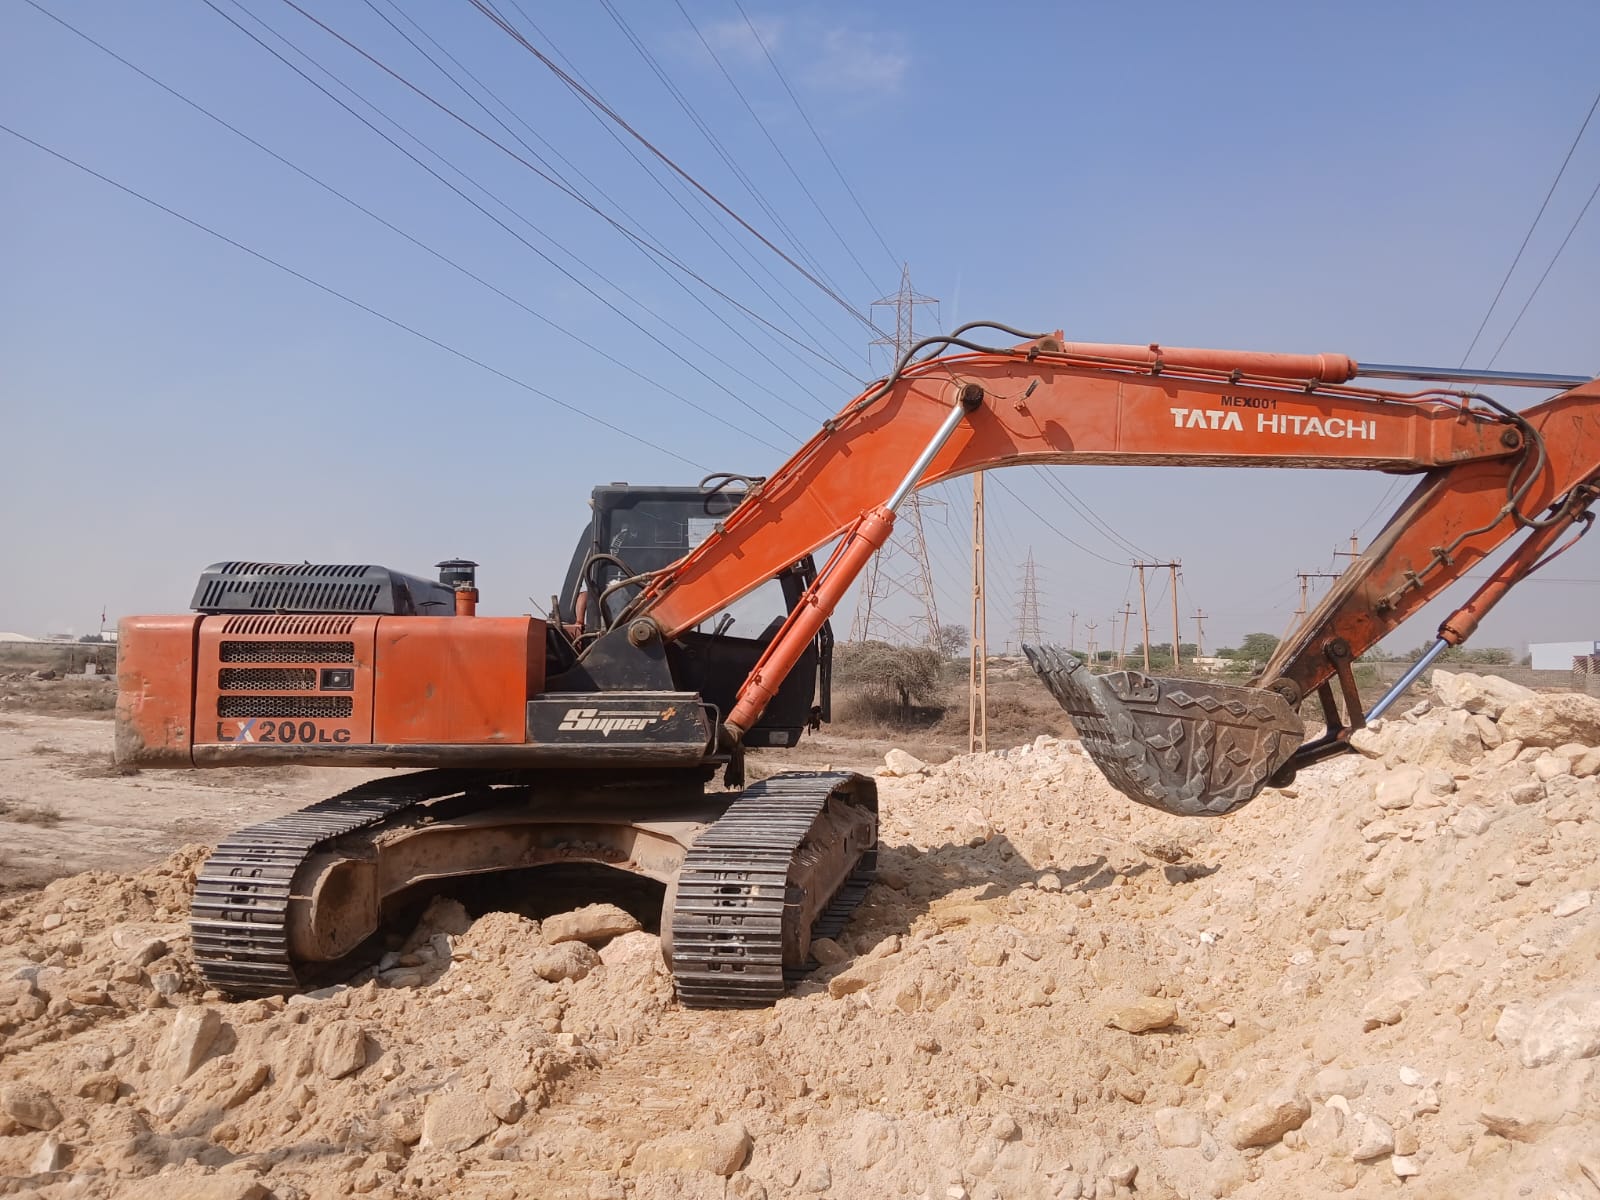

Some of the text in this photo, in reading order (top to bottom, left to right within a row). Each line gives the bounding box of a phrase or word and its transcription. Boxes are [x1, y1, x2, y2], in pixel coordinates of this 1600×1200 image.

[1220, 395, 1277, 409] MEX001
[1170, 407, 1376, 440] TATA HITACHI
